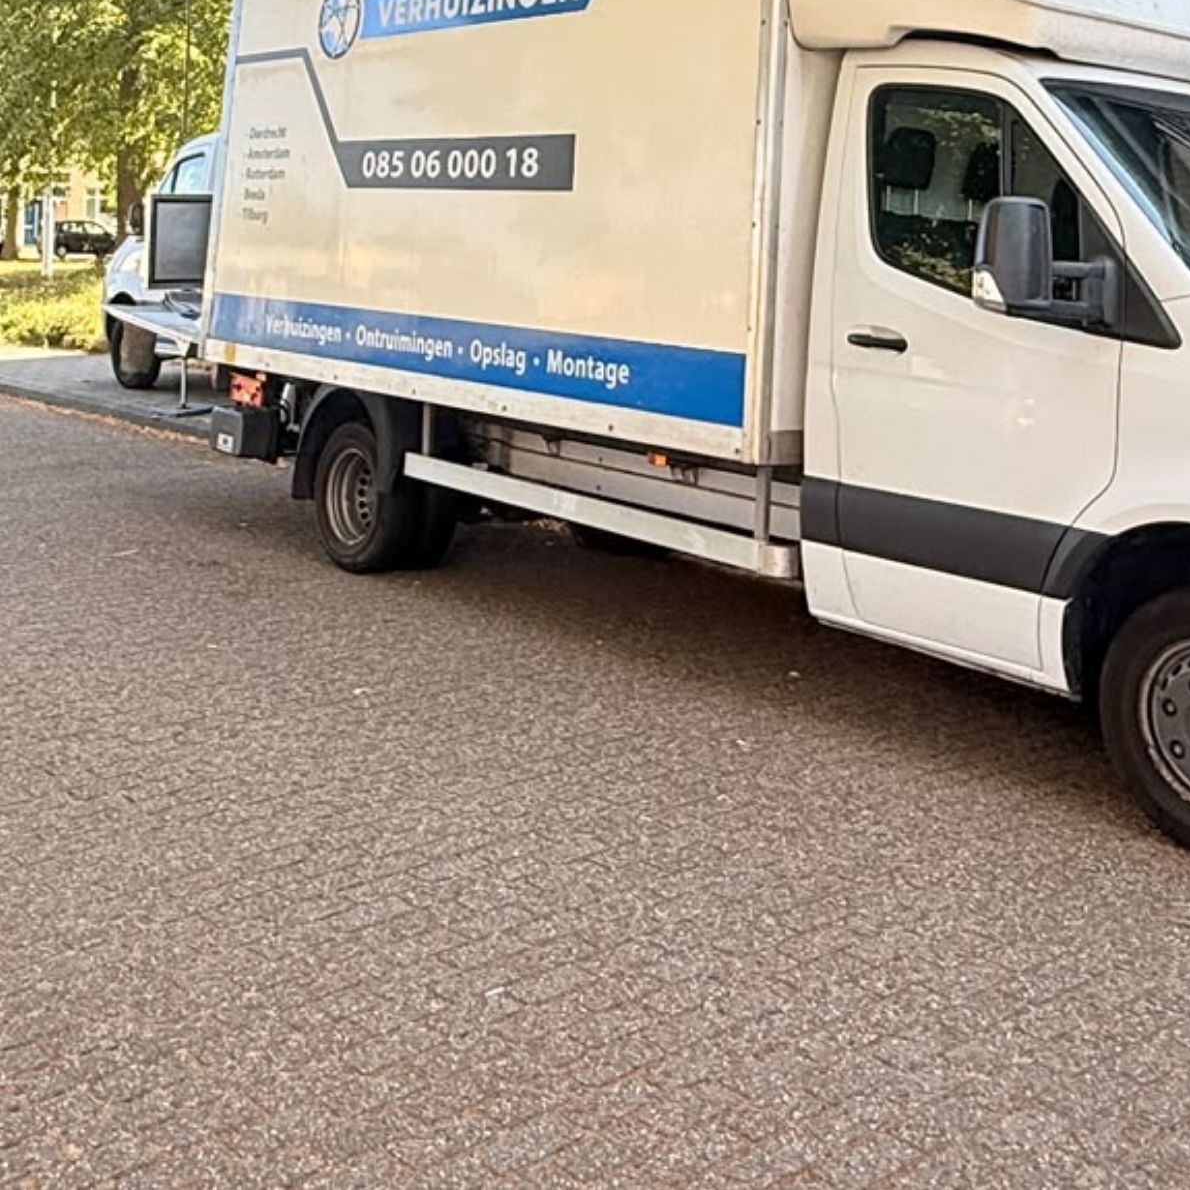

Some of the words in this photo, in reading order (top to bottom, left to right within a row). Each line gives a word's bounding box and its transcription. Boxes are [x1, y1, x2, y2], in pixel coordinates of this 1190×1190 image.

[362, 150, 404, 179] 085
[410, 150, 441, 179] 06
[447, 148, 497, 179] 000
[505, 147, 539, 179] 18
[265, 313, 342, 346] Verhuizingen
[354, 324, 453, 361] Ontruimingen
[470, 339, 527, 376] Opslag
[546, 349, 630, 389] Montage
